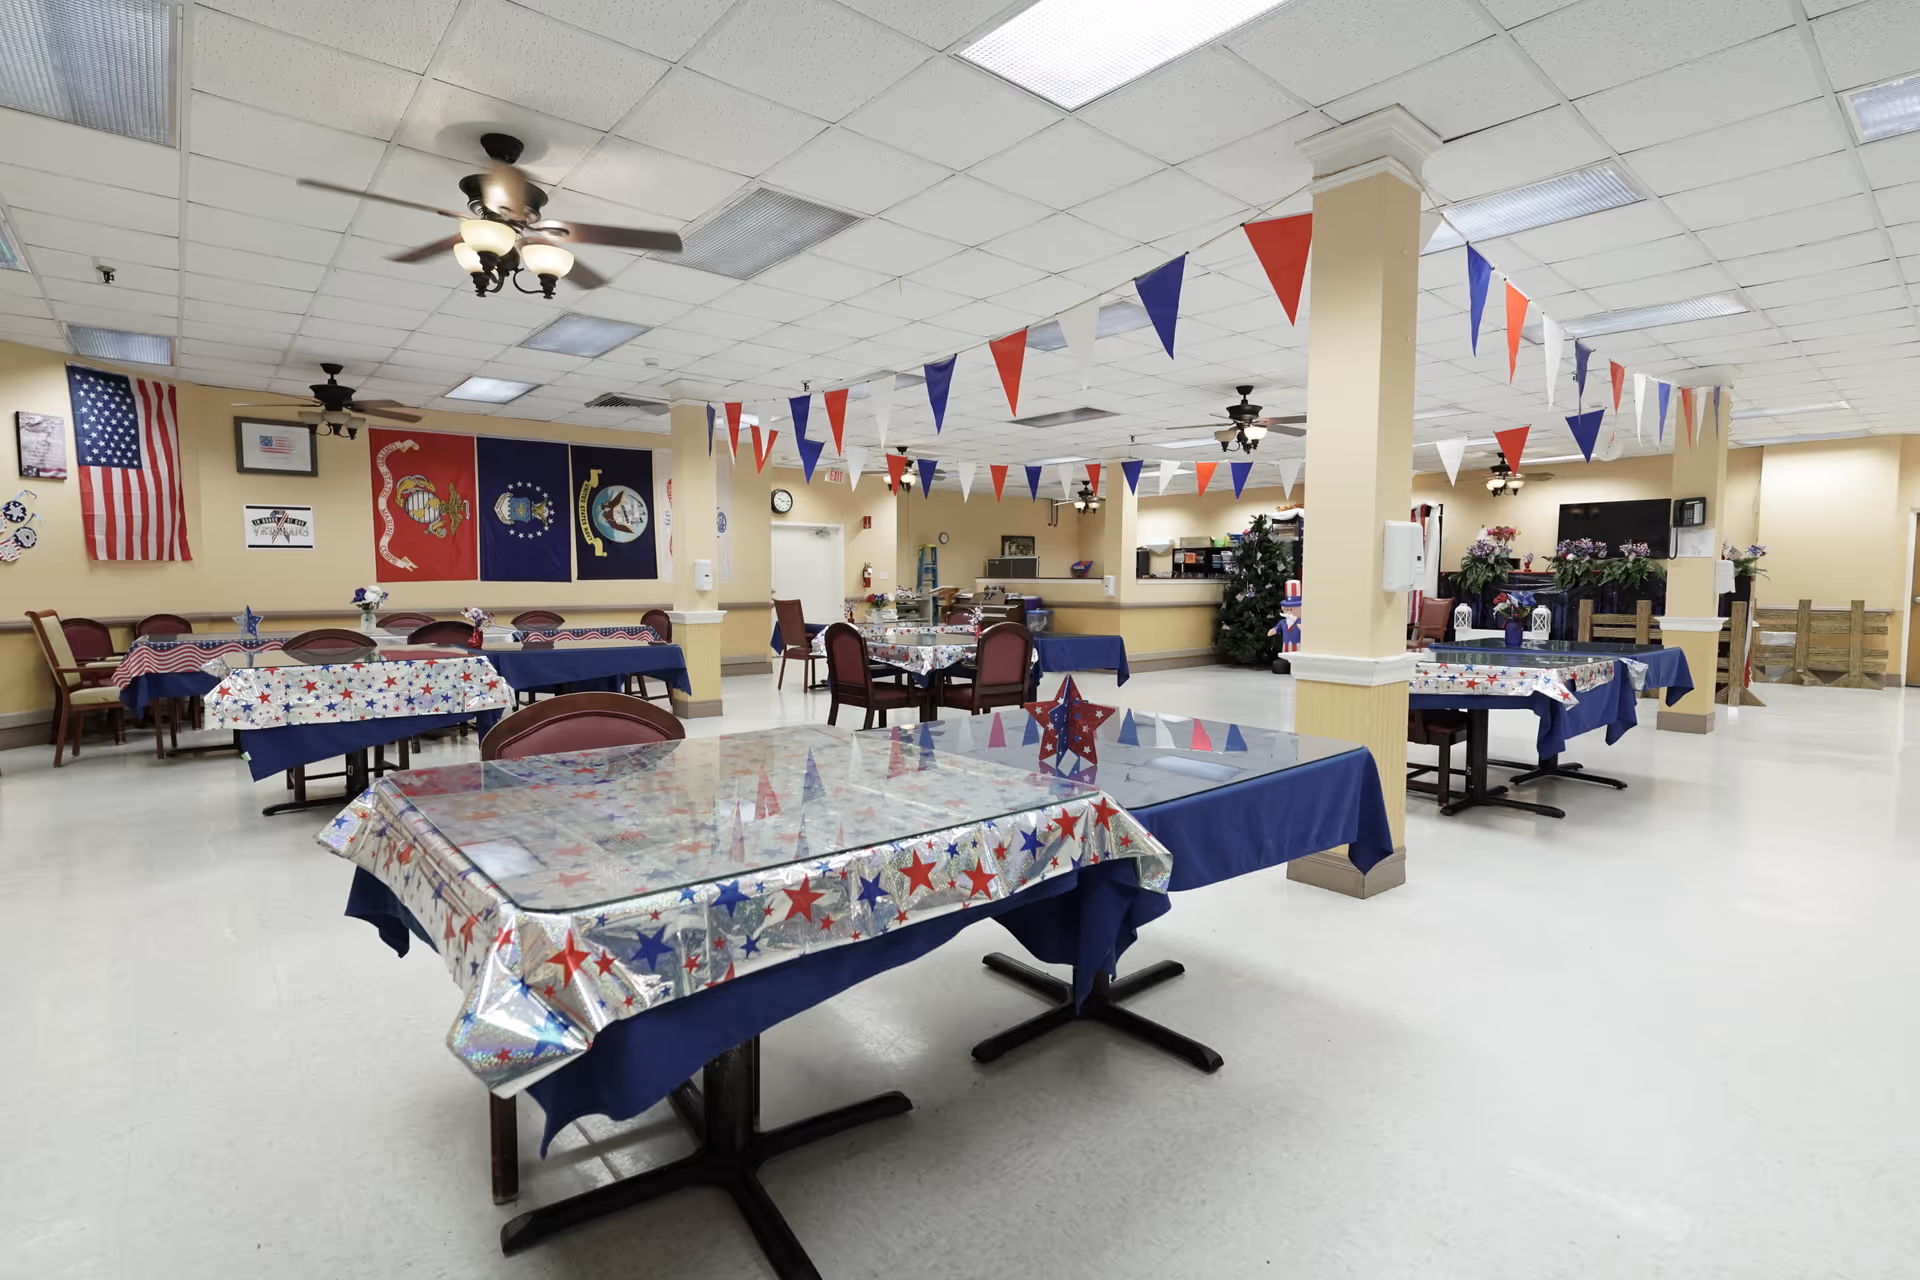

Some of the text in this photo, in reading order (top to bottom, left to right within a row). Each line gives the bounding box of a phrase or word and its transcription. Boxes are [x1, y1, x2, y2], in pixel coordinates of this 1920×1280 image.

[829, 469, 843, 482] EXIT
[580, 483, 590, 504] UNITED
[377, 443, 399, 565] UNITED STATES MARINE CORPS
[583, 527, 593, 541] NAVY
